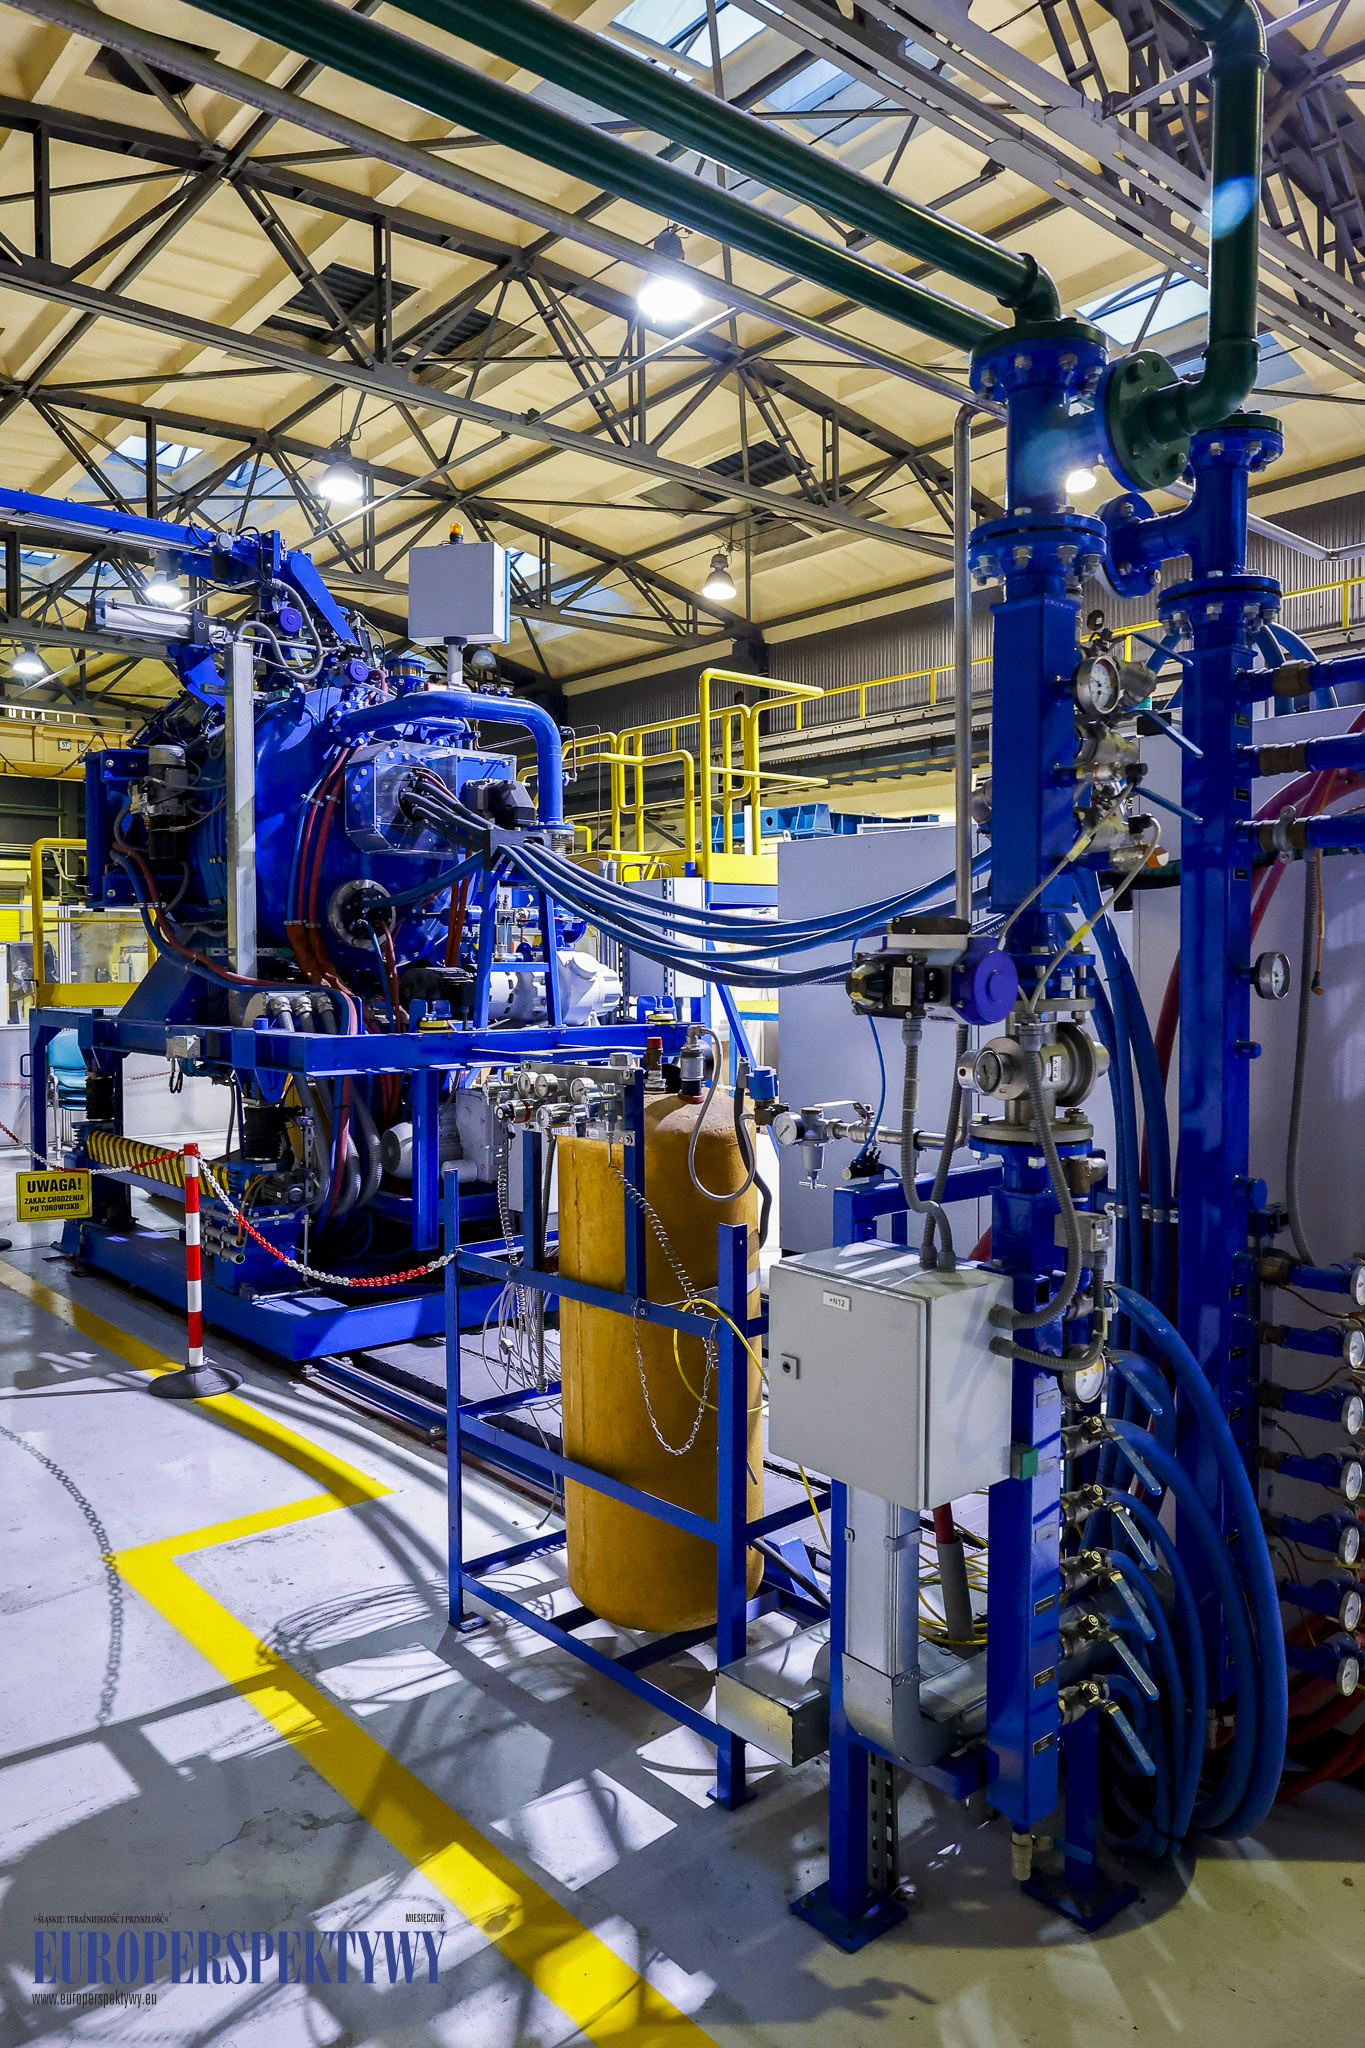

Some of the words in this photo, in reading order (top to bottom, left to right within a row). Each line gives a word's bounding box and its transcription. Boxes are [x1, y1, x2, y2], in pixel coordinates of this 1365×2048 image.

[27, 1178, 82, 1193] UWAGA!
[24, 1196, 46, 1204] ZAKAZ
[48, 1194, 84, 1203] CHODZENIA
[41, 1202, 80, 1212] TOROWISKU
